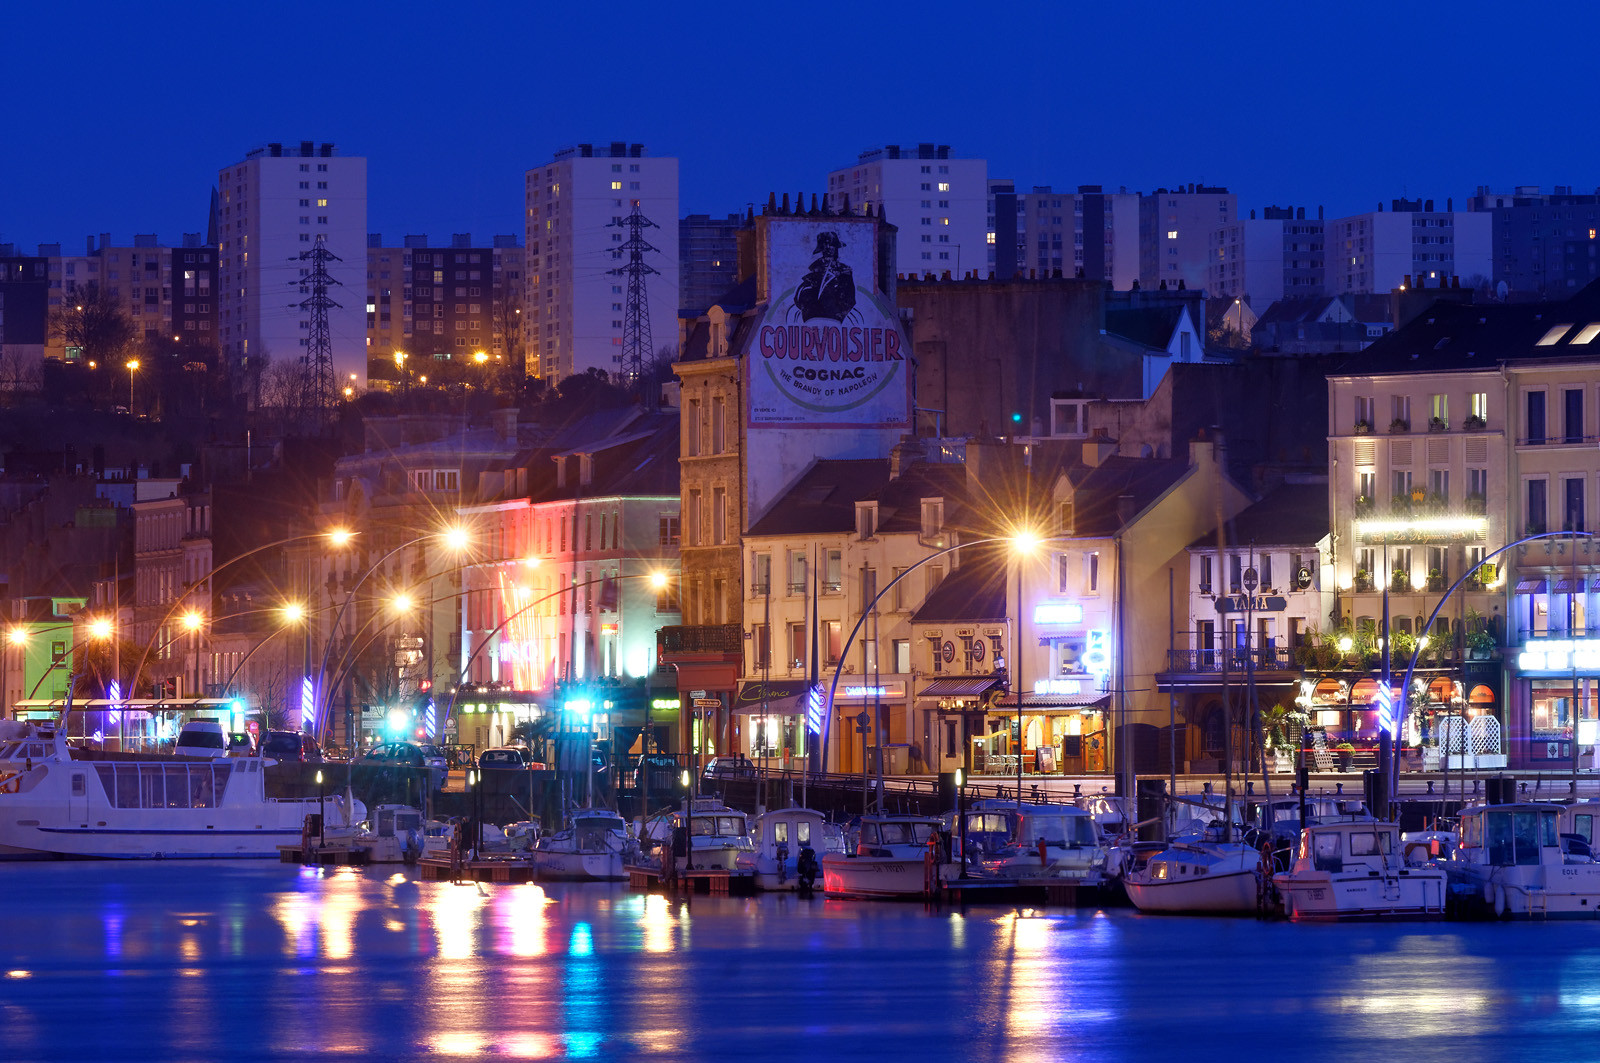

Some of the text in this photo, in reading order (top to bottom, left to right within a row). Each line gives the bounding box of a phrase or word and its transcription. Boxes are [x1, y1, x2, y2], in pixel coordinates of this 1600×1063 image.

[760, 325, 904, 362] COURVOISIER
[780, 369, 878, 396] THE BRANDY OF NAPOLEON
[793, 366, 865, 381] COGNAC
